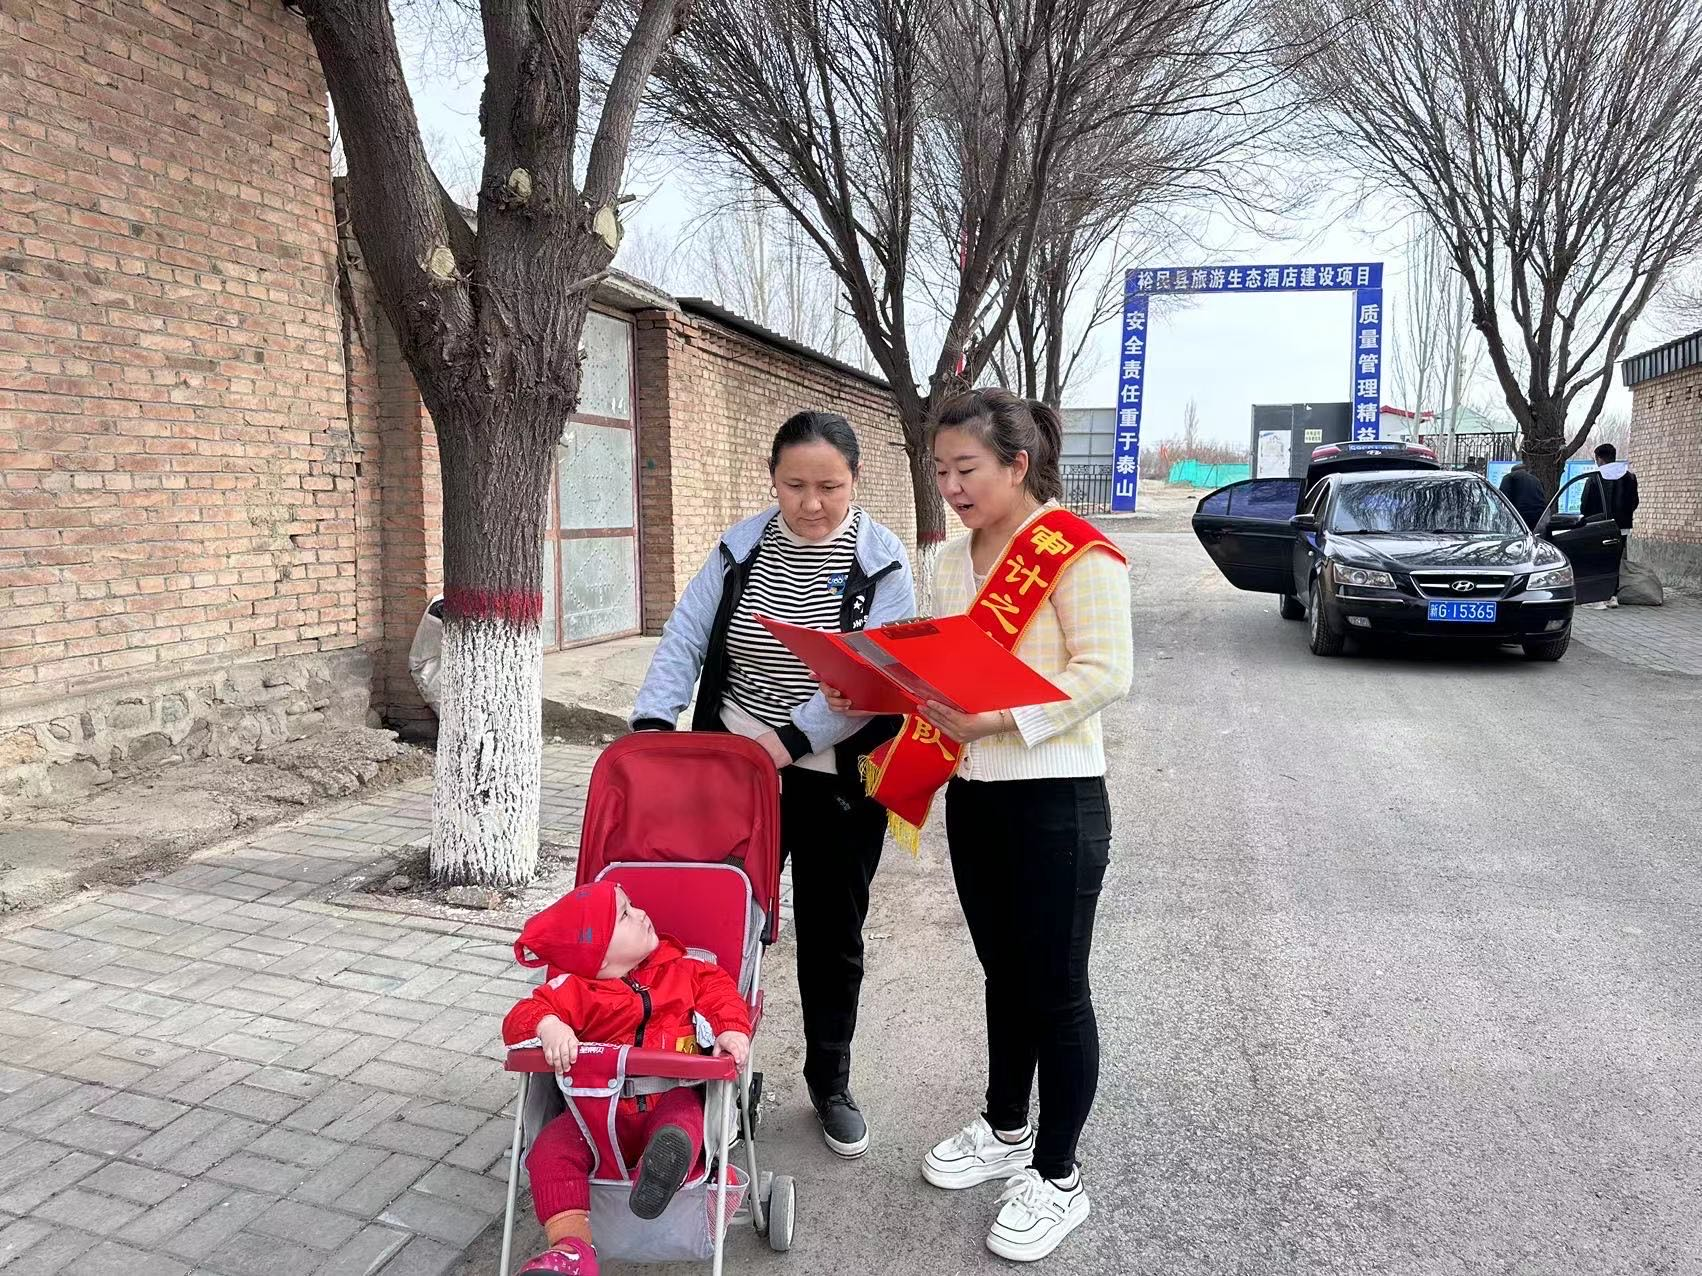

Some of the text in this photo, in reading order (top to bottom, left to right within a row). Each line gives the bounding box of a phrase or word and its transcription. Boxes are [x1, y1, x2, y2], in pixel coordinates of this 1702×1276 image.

[1115, 310, 1146, 498] 安全责任重于泰山
